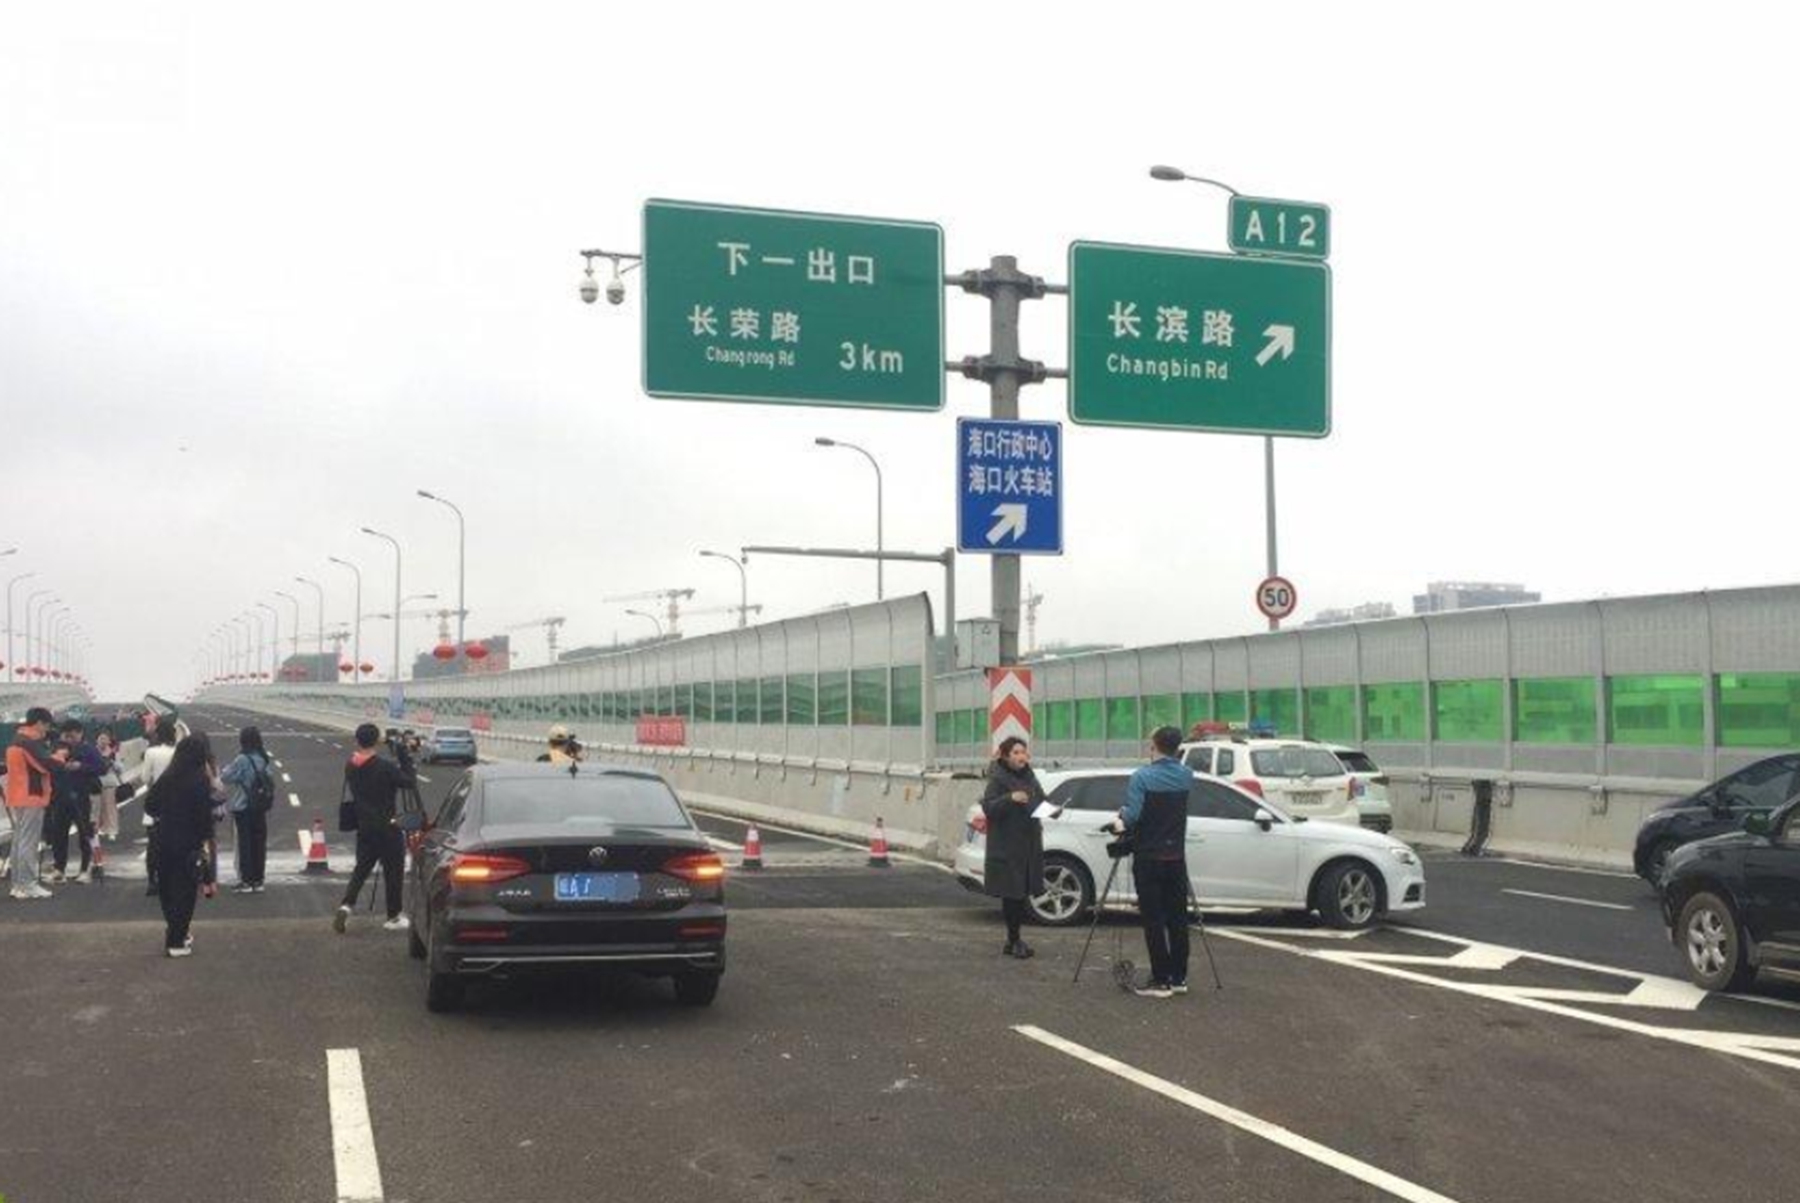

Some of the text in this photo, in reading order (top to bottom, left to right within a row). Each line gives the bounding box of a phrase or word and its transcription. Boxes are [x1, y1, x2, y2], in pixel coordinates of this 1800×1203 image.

[1245, 210, 1316, 247] A12
[717, 241, 875, 285] 下一出口
[688, 304, 801, 343] 长荣路
[1108, 301, 1235, 347] 长滨路
[706, 346, 796, 370] Changrong Rd
[1106, 353, 1229, 382] Changbin Rd
[967, 427, 1053, 461] 海口行政中心
[968, 464, 1053, 496] 海口火车站
[1264, 588, 1290, 607] 50
